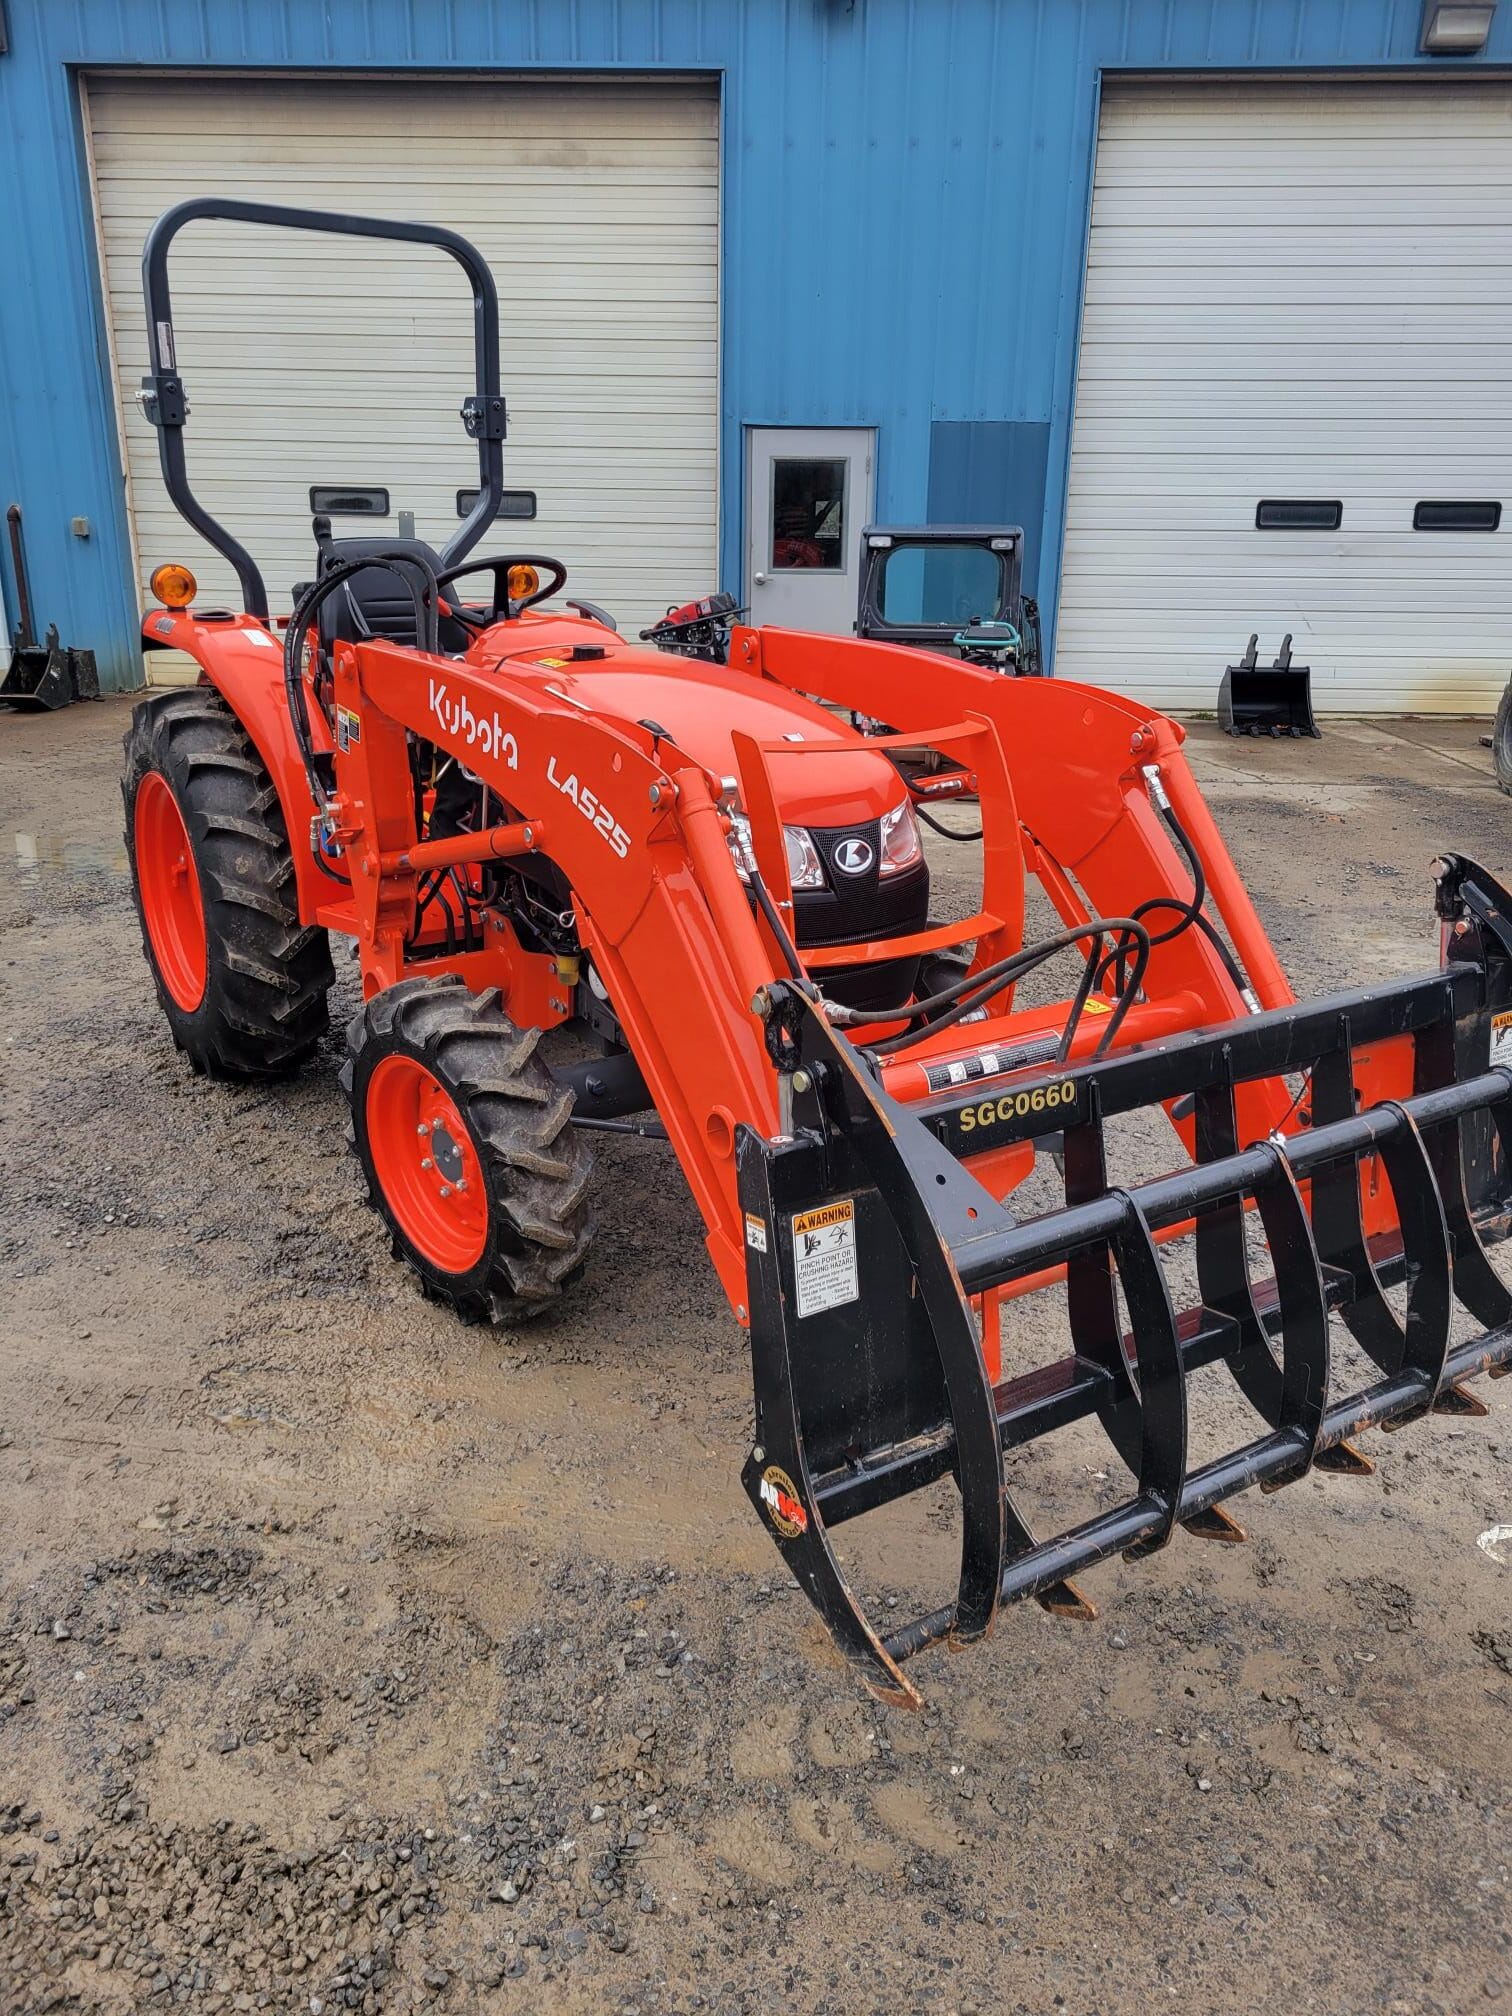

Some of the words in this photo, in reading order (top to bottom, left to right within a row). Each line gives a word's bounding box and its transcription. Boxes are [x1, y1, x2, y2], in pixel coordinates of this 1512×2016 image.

[429, 678, 518, 771] Kubota
[546, 756, 632, 859] LA525
[960, 1081, 1076, 1131] SGC0660
[808, 1205, 851, 1229] WARNING
[799, 1264, 829, 1280] CRUSHING
[830, 1256, 854, 1270] HAZARD
[800, 1258, 820, 1271] PINCH
[821, 1252, 841, 1265] POINT
[841, 1249, 851, 1259] OR
